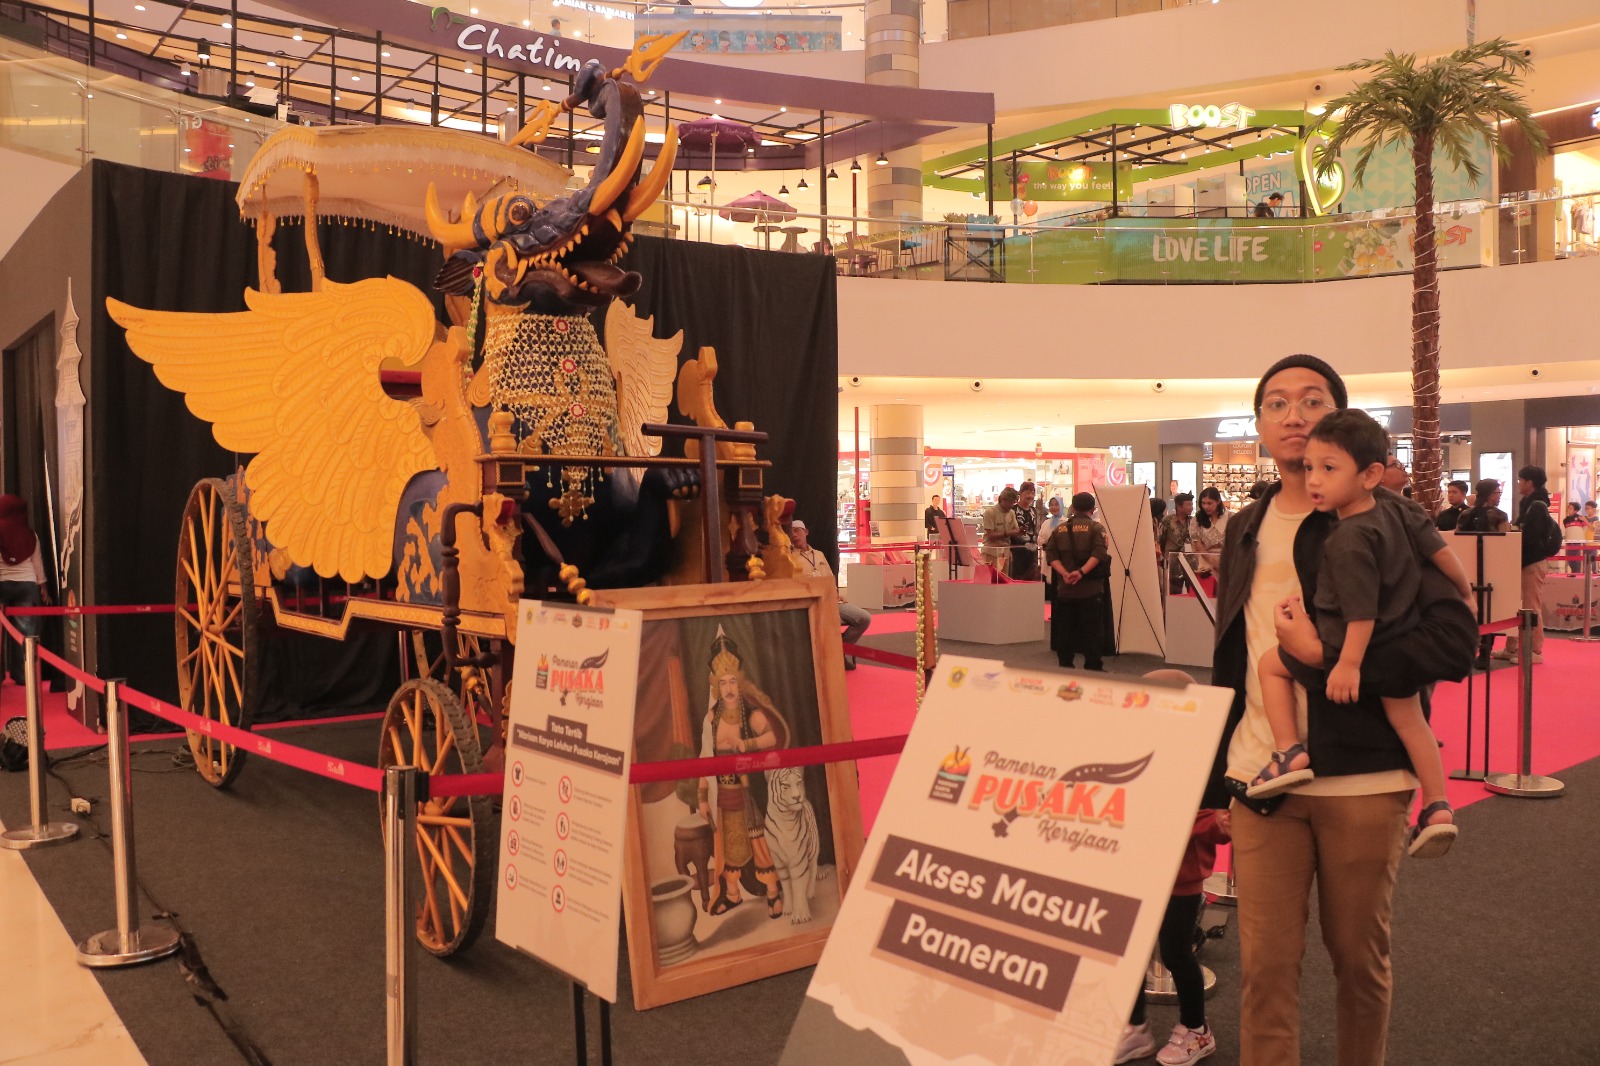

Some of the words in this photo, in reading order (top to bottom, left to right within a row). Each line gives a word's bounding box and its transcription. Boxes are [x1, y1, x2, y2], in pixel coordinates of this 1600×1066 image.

[457, 24, 600, 72] Chatim
[1170, 102, 1256, 131] BOOST
[1033, 182, 1048, 190] the
[1049, 184, 1067, 193] way
[1069, 182, 1089, 193] you
[1153, 235, 1210, 263] LOVE
[1214, 235, 1270, 263] LIFE
[552, 654, 579, 669] Pameran
[550, 669, 604, 693] PUSAKA
[551, 721, 565, 735] Tata
[565, 725, 583, 740] Tertib
[538, 734, 553, 749] Karya
[553, 738, 574, 753] Leluhur
[573, 744, 594, 759] Pusaka
[984, 750, 1057, 780] Pameran
[968, 774, 1126, 829] PUSAKA
[1037, 819, 1120, 855] Kerajaan
[895, 848, 986, 900] Akses
[991, 872, 1109, 935] Masuk
[901, 912, 1050, 990] Pameran
